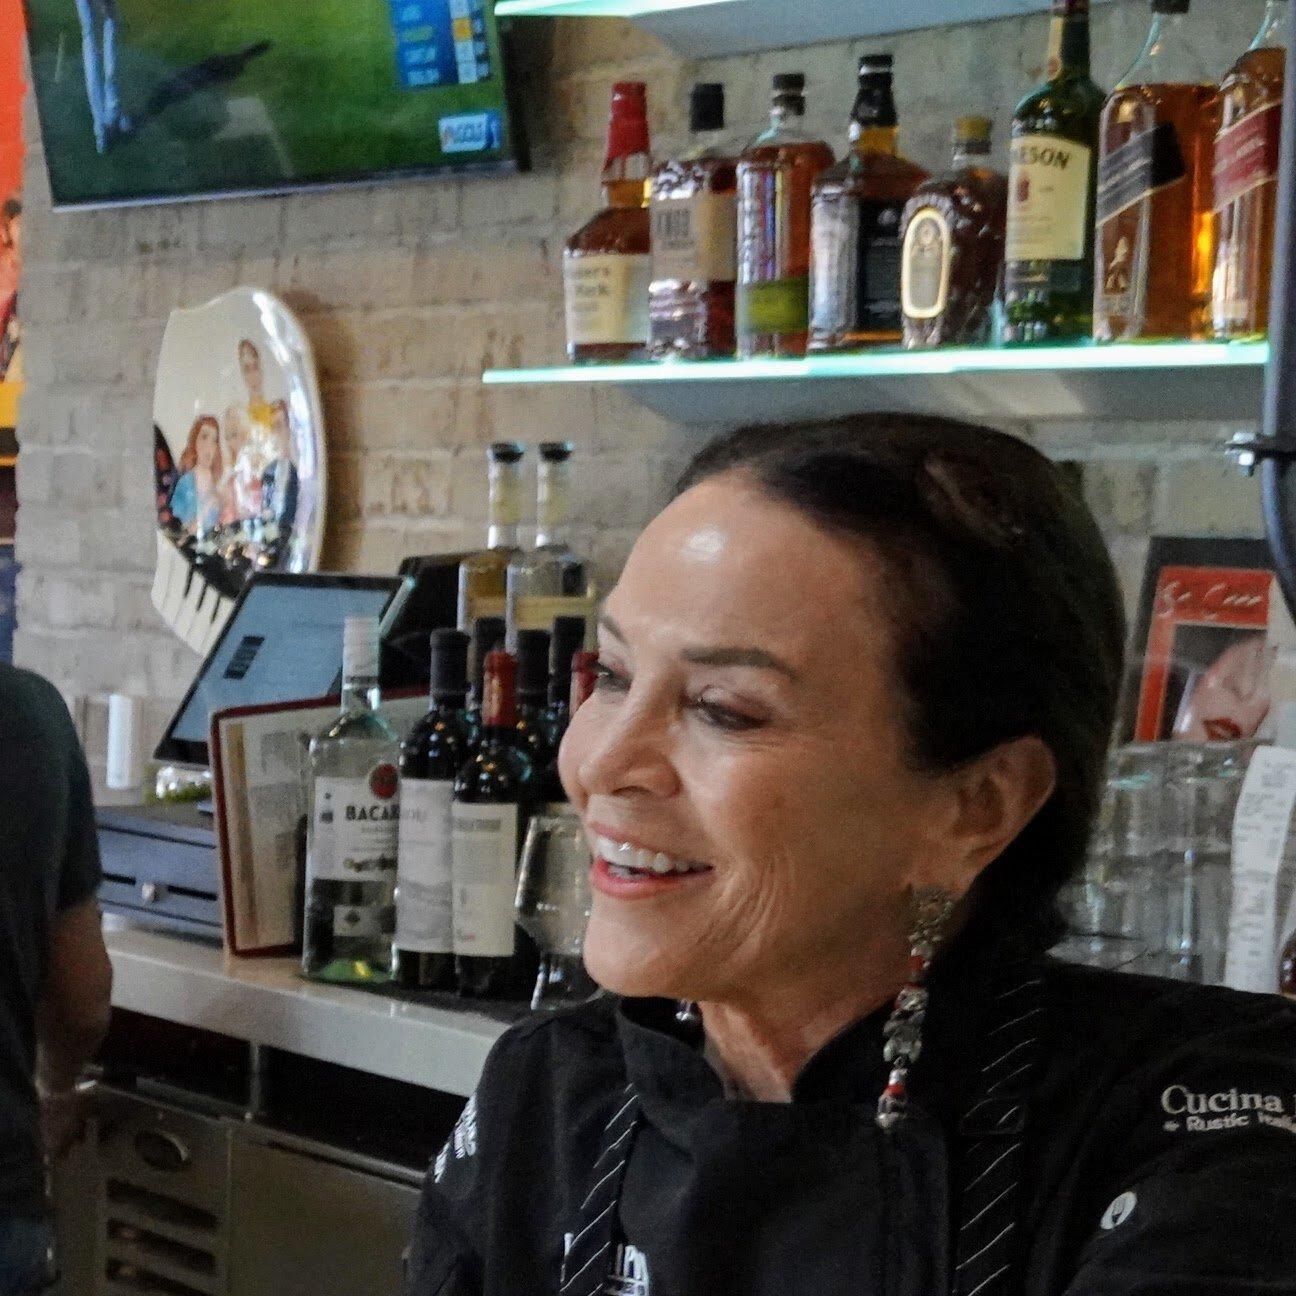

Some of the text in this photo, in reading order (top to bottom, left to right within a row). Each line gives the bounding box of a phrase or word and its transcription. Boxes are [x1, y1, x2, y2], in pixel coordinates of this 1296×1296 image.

[345, 804, 401, 822] BACAR
[1161, 1084, 1284, 1115] Cucina
[1186, 1112, 1250, 1131] Rustic
